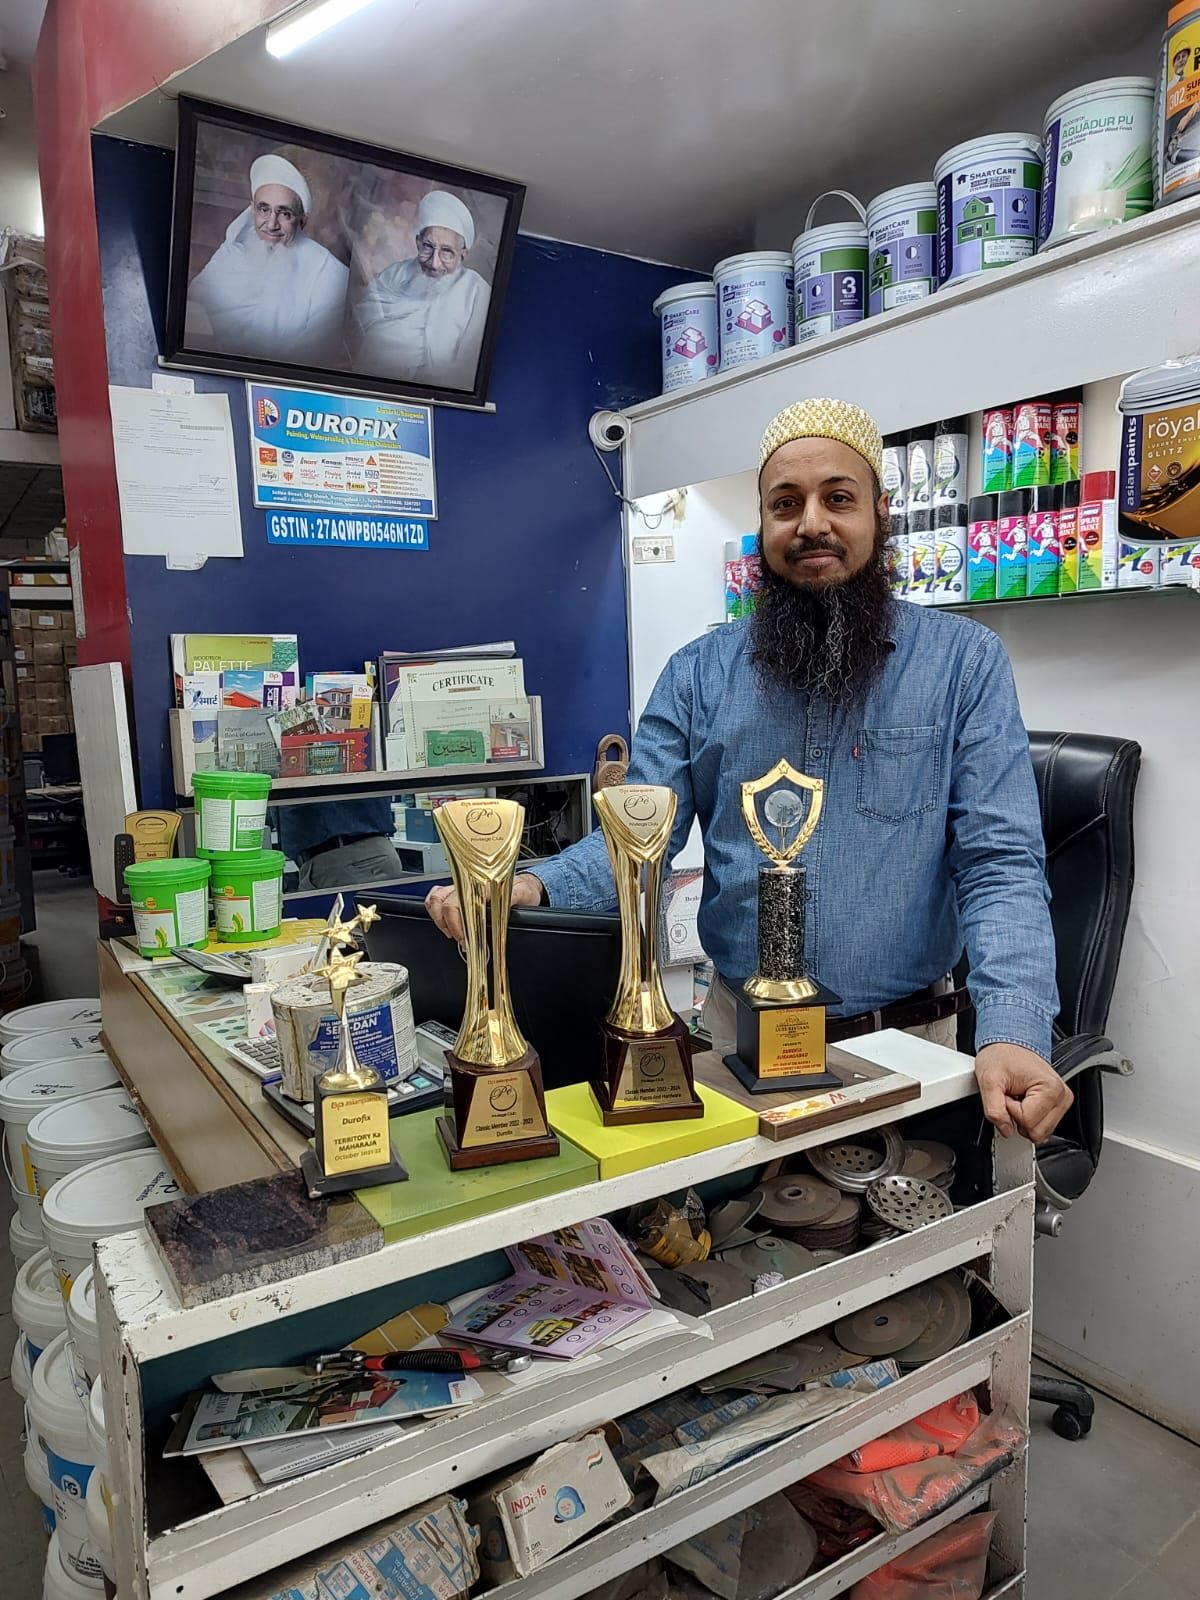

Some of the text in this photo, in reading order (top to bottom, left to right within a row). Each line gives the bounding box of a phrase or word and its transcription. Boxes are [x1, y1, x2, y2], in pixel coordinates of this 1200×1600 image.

[1117, 113, 1134, 125] PU
[939, 184, 950, 278] asianpaints
[841, 276, 857, 294] 3
[286, 409, 399, 440] DUROFIX
[1147, 447, 1183, 459] GLITZ
[1126, 416, 1139, 507] asianpaints
[193, 660, 254, 672] PALETTE
[432, 674, 495, 692] CERTIFICATE
[342, 1113, 372, 1126] Durofix
[475, 1123, 491, 1132] Classic
[491, 1121, 508, 1130] Member
[333, 1133, 371, 1145] TERRITORY
[338, 1140, 377, 1153] MAHARAJA
[334, 1151, 360, 1161] October
[511, 1484, 548, 1514] INDi-16
